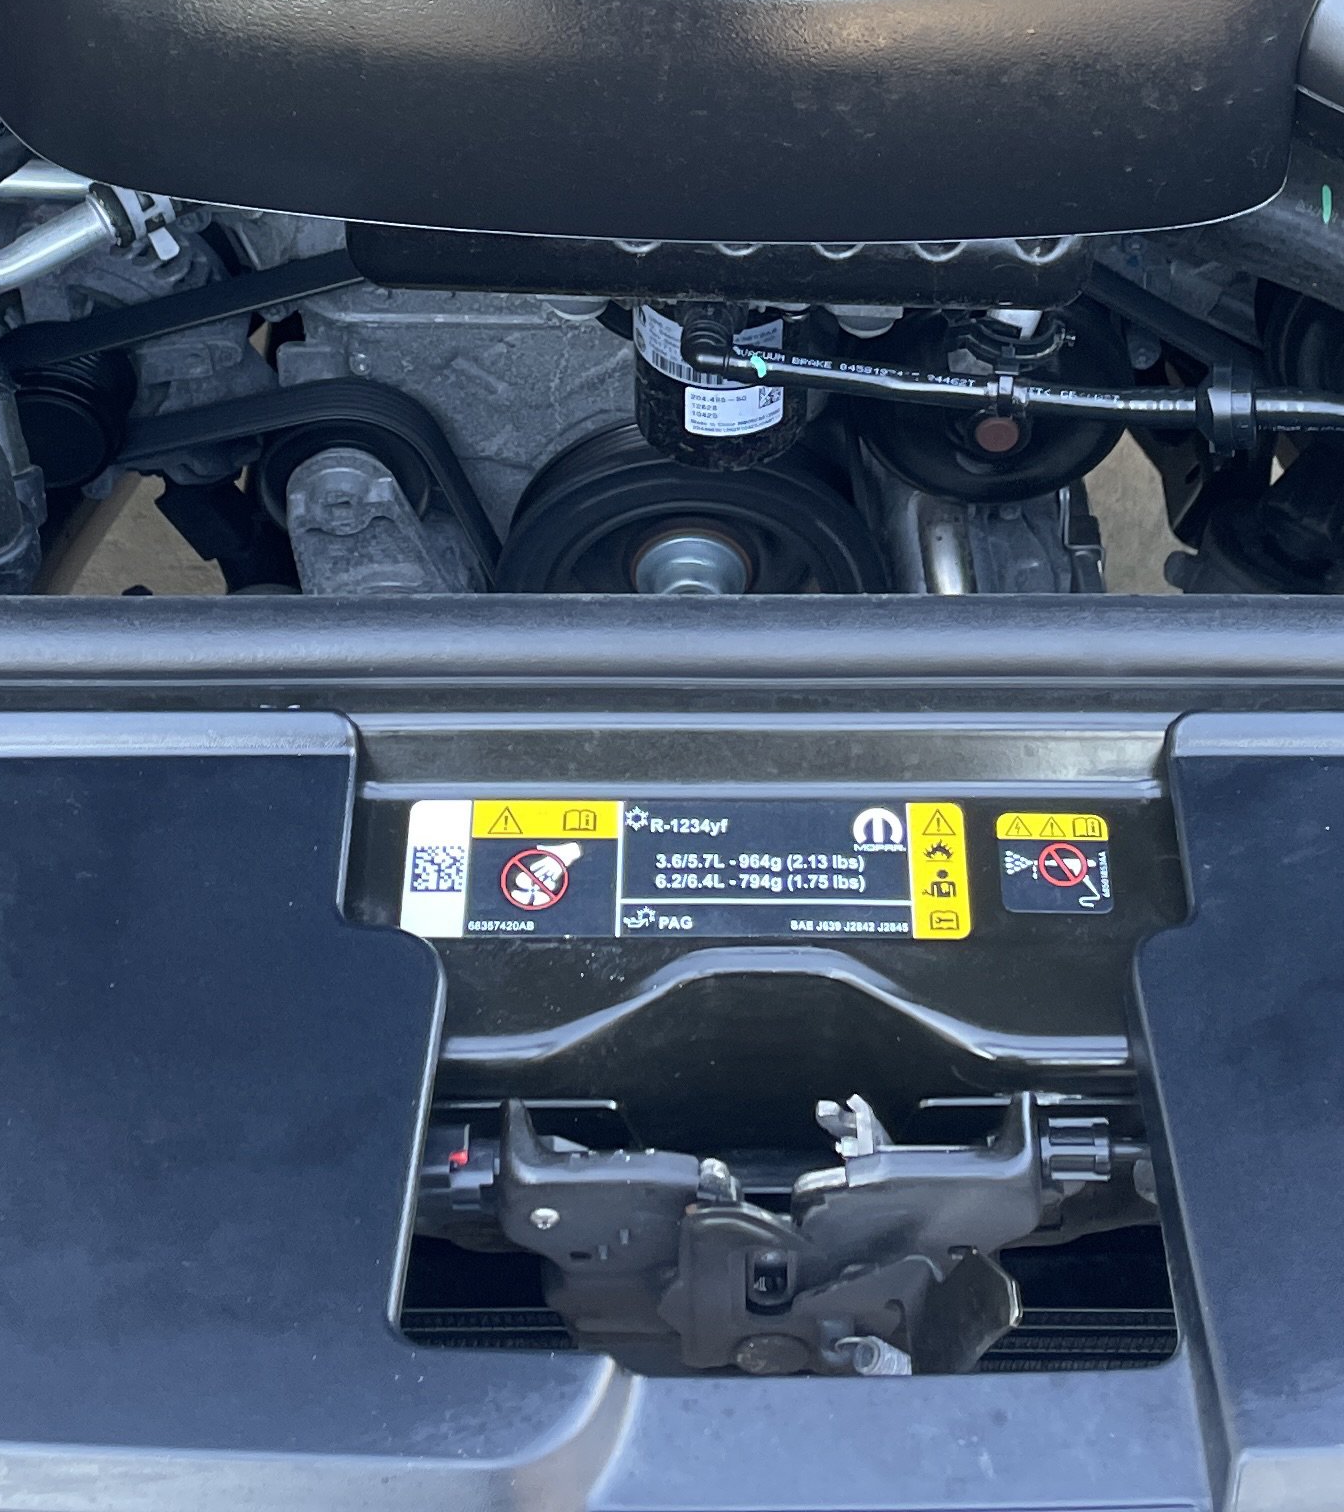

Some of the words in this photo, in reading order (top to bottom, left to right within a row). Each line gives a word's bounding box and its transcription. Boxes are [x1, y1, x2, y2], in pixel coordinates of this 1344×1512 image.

[790, 356, 833, 369] BRAKE
[650, 819, 728, 836] R-1234yf
[656, 854, 725, 869] 3.6/5.7L
[739, 855, 781, 872] 964g
[787, 854, 827, 871] (2.13
[833, 855, 864, 872] lbs)
[655, 874, 725, 889] 6.2/6.4L
[739, 875, 782, 892] 794g
[787, 874, 828, 892] (1.75
[833, 875, 865, 892] lbs)
[658, 916, 693, 929] PAG
[791, 920, 813, 931] SAE
